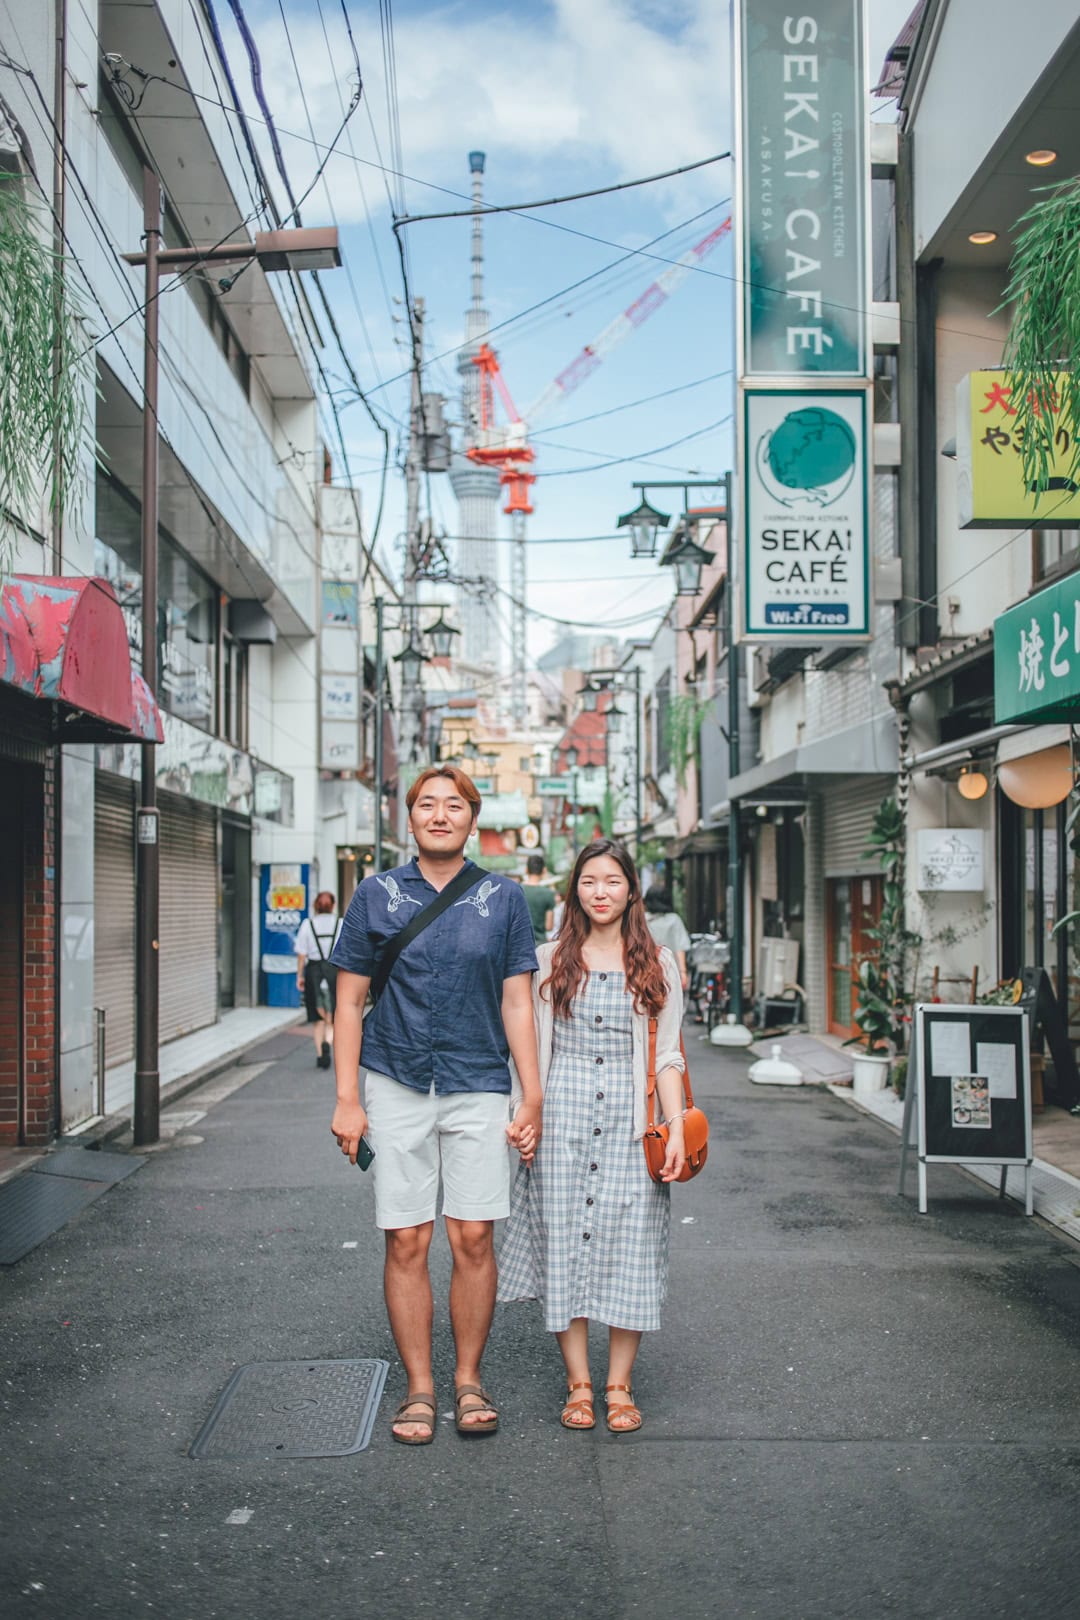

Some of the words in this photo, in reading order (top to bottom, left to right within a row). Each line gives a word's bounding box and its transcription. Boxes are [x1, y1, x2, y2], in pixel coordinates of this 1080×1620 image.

[782, 16, 820, 179] SEKAI
[832, 111, 844, 199] COSMOPOLITAN
[833, 206, 845, 257] KITCHEN
[785, 208, 833, 355] CAFÉ
[766, 554, 848, 582] CAFÉ
[770, 610, 809, 624] Wi-Fi
[811, 610, 846, 624] Free
